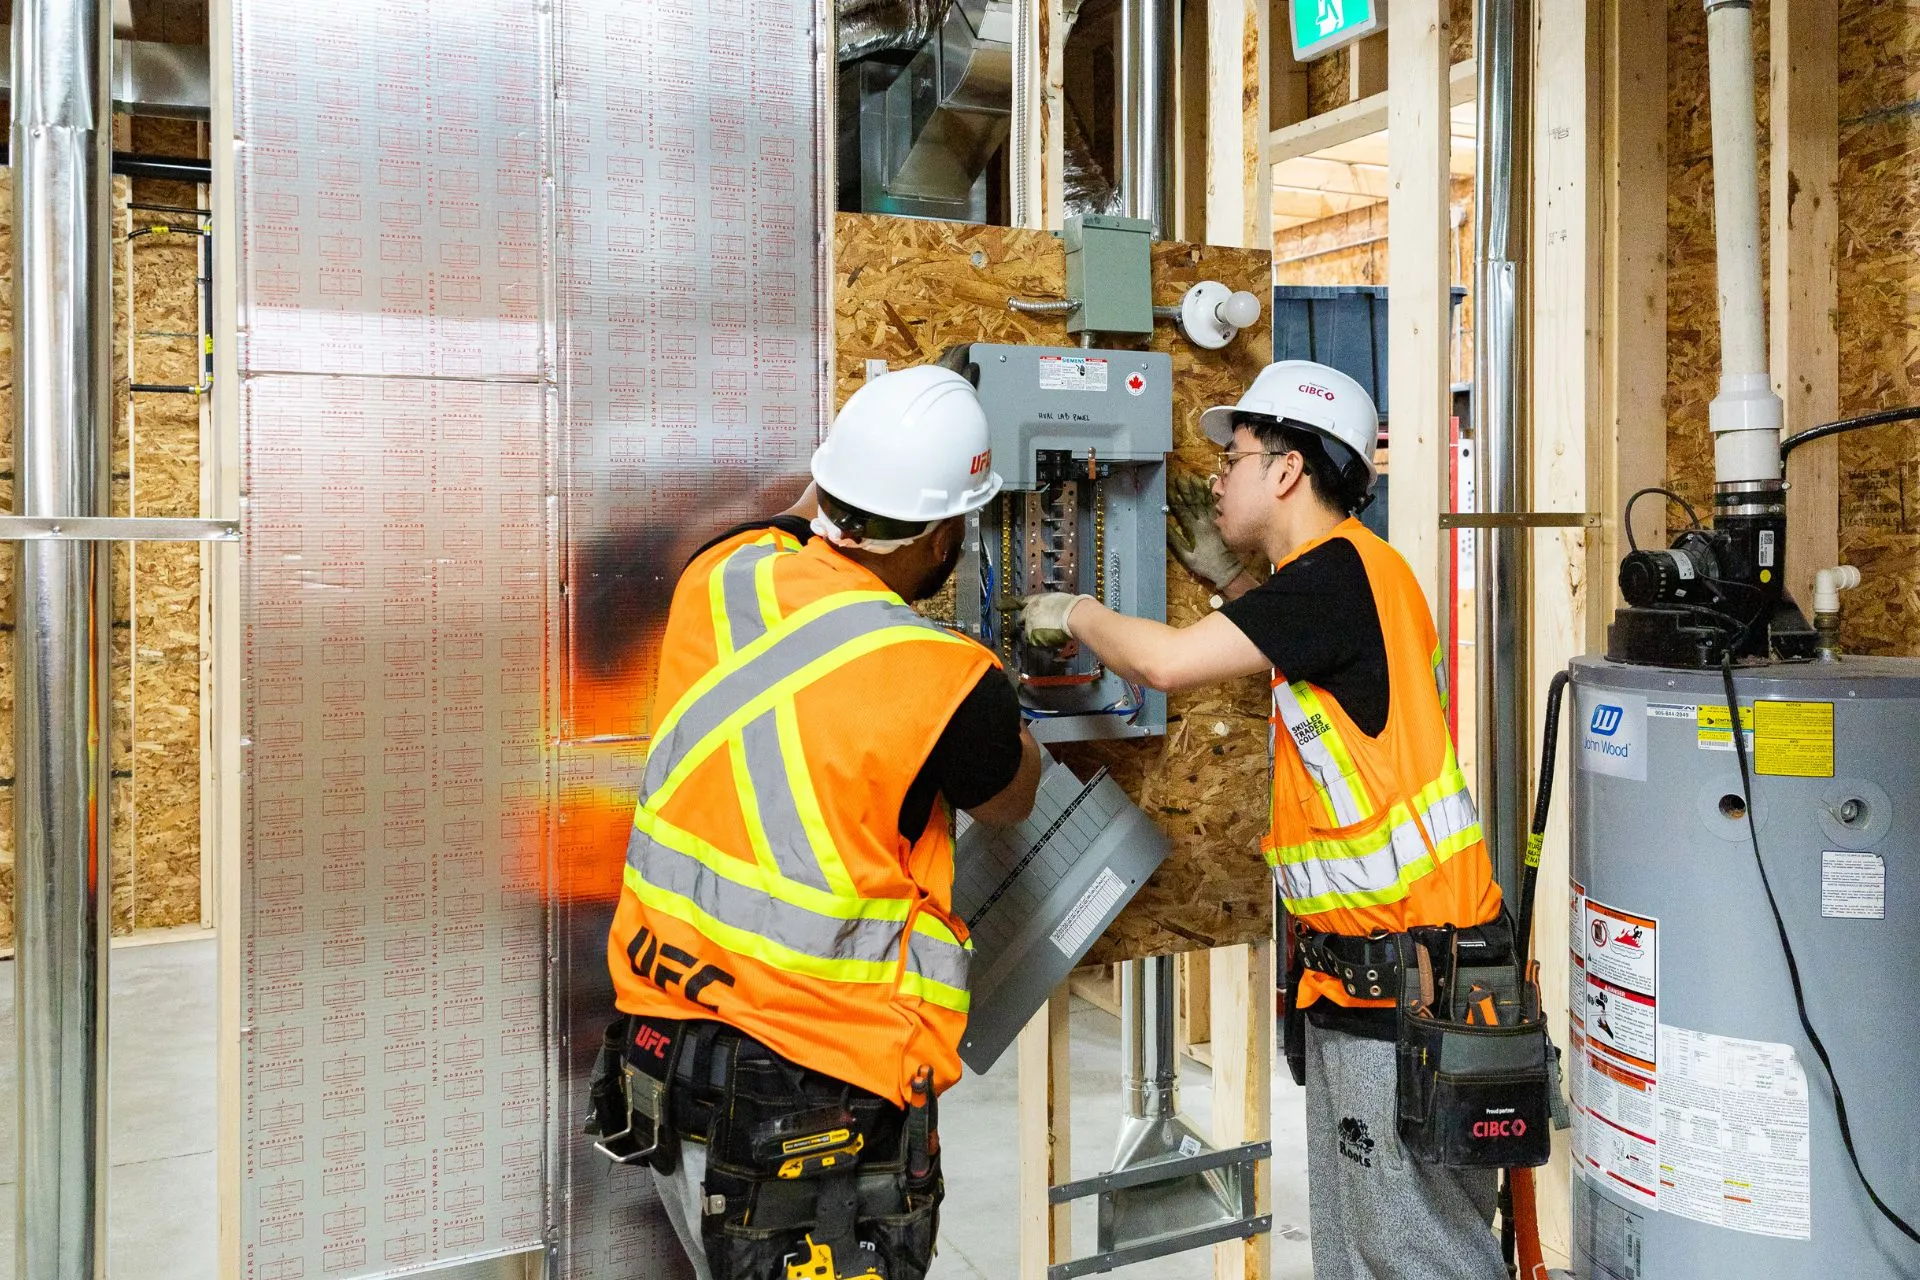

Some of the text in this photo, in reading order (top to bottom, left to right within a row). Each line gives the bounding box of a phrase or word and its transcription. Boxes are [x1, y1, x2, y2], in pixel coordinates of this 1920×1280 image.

[1298, 384, 1324, 398] CIBC
[1057, 412, 1070, 420] LAB
[1073, 413, 1090, 421] PANEL
[1291, 713, 1321, 734] SKILLED
[1295, 719, 1324, 739] TRADES
[1298, 723, 1332, 746] COLLEGE
[1584, 737, 1628, 757] John Wood
[627, 925, 735, 1015] UFC
[635, 1025, 671, 1058] UFC
[1473, 1120, 1510, 1137] CIBC
[1340, 1140, 1371, 1168] Roots
